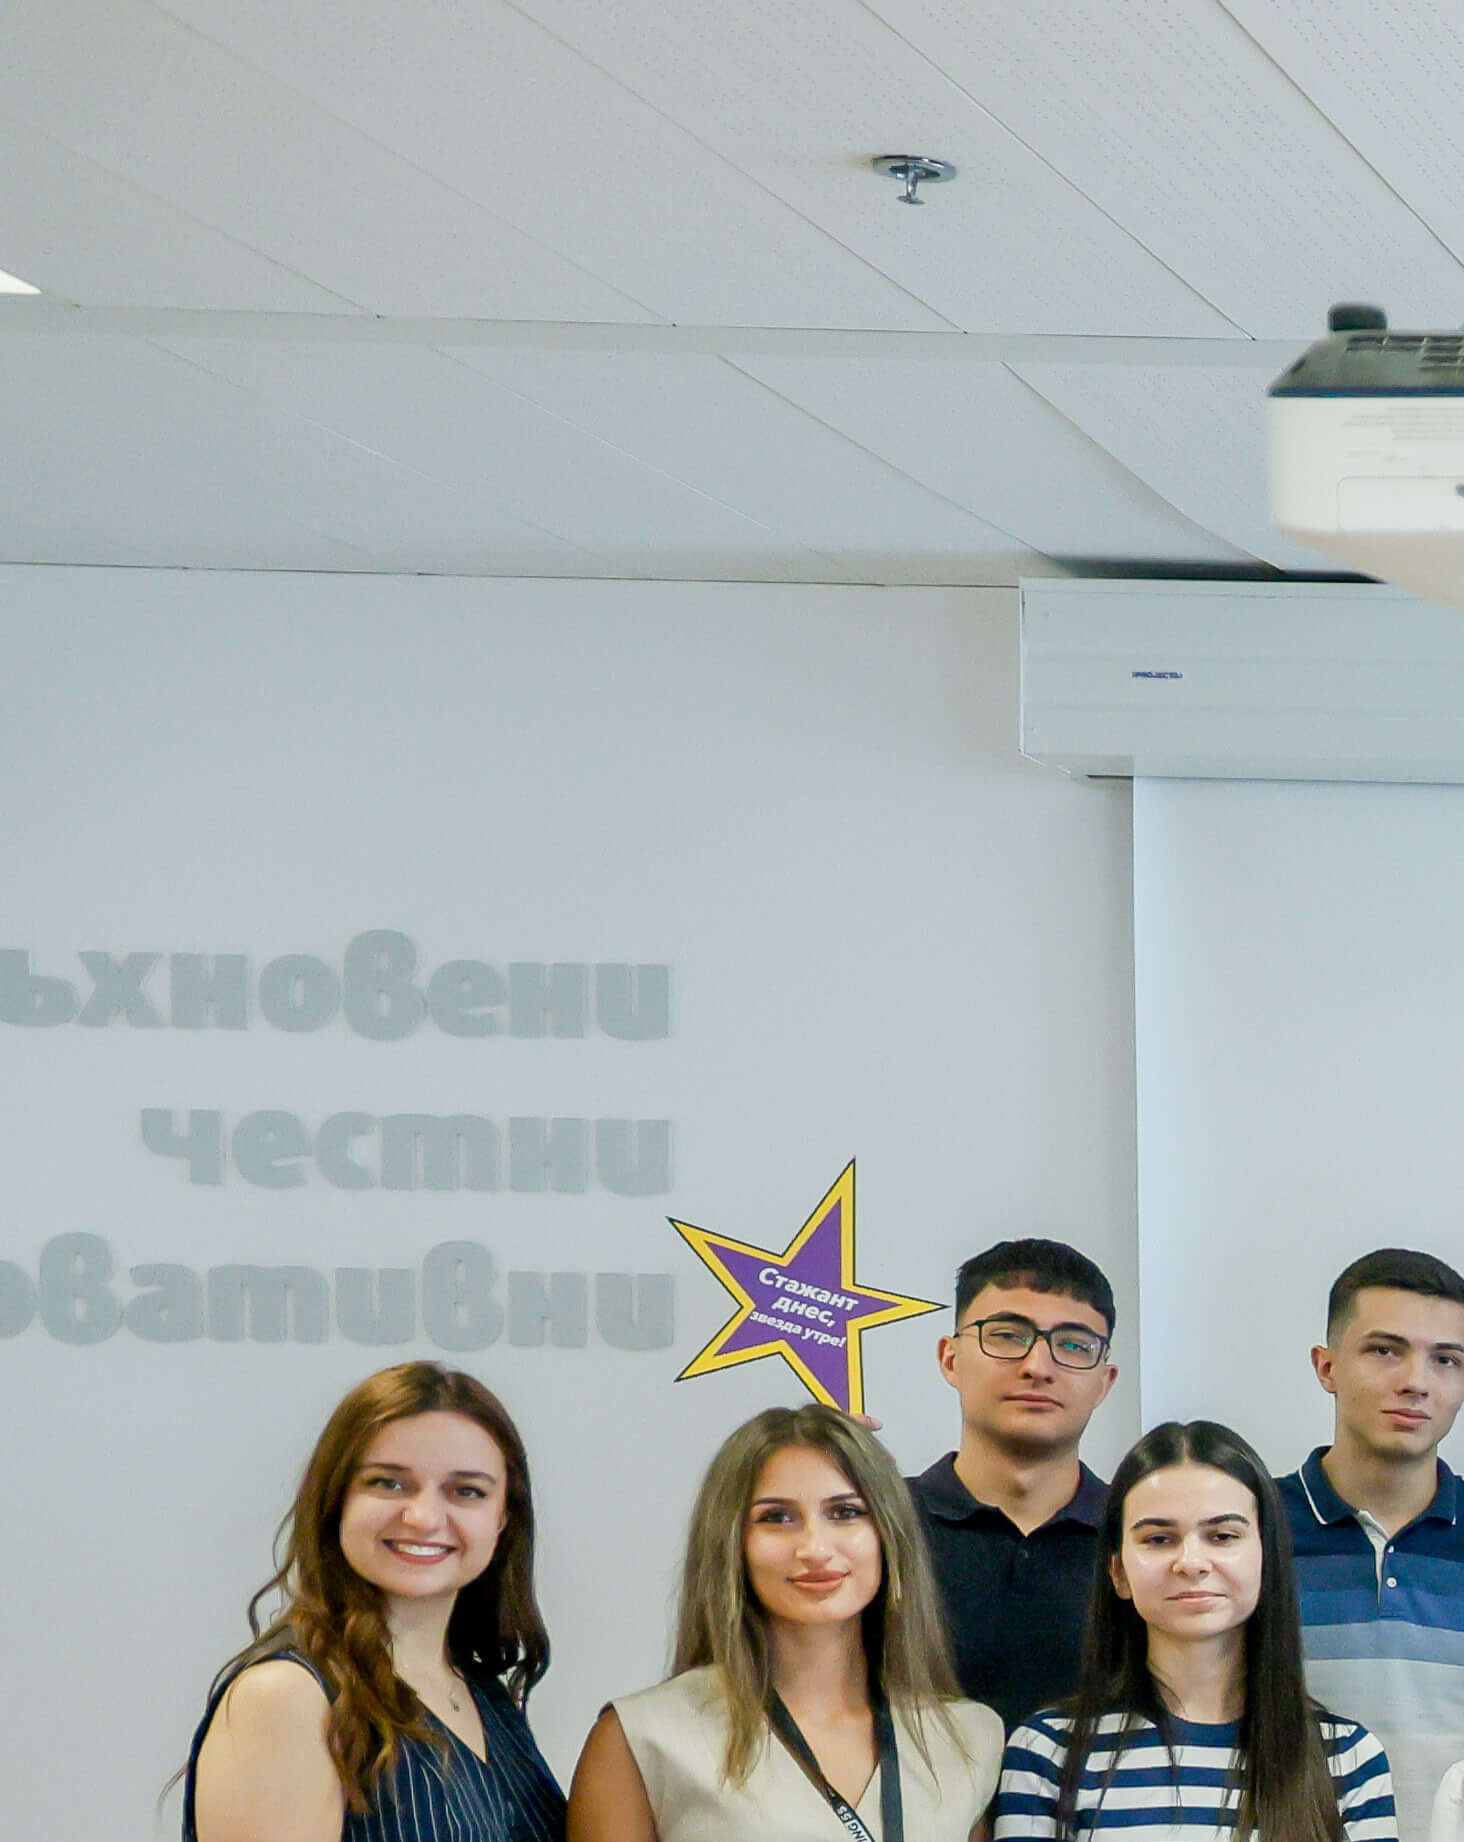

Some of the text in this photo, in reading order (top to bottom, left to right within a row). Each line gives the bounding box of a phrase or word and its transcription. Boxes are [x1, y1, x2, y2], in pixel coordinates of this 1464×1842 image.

[141, 1106, 672, 1196] честни
[758, 1267, 859, 1312] Стажант
[749, 1311, 847, 1348] звезда утре!
[771, 1296, 836, 1328] днес,
